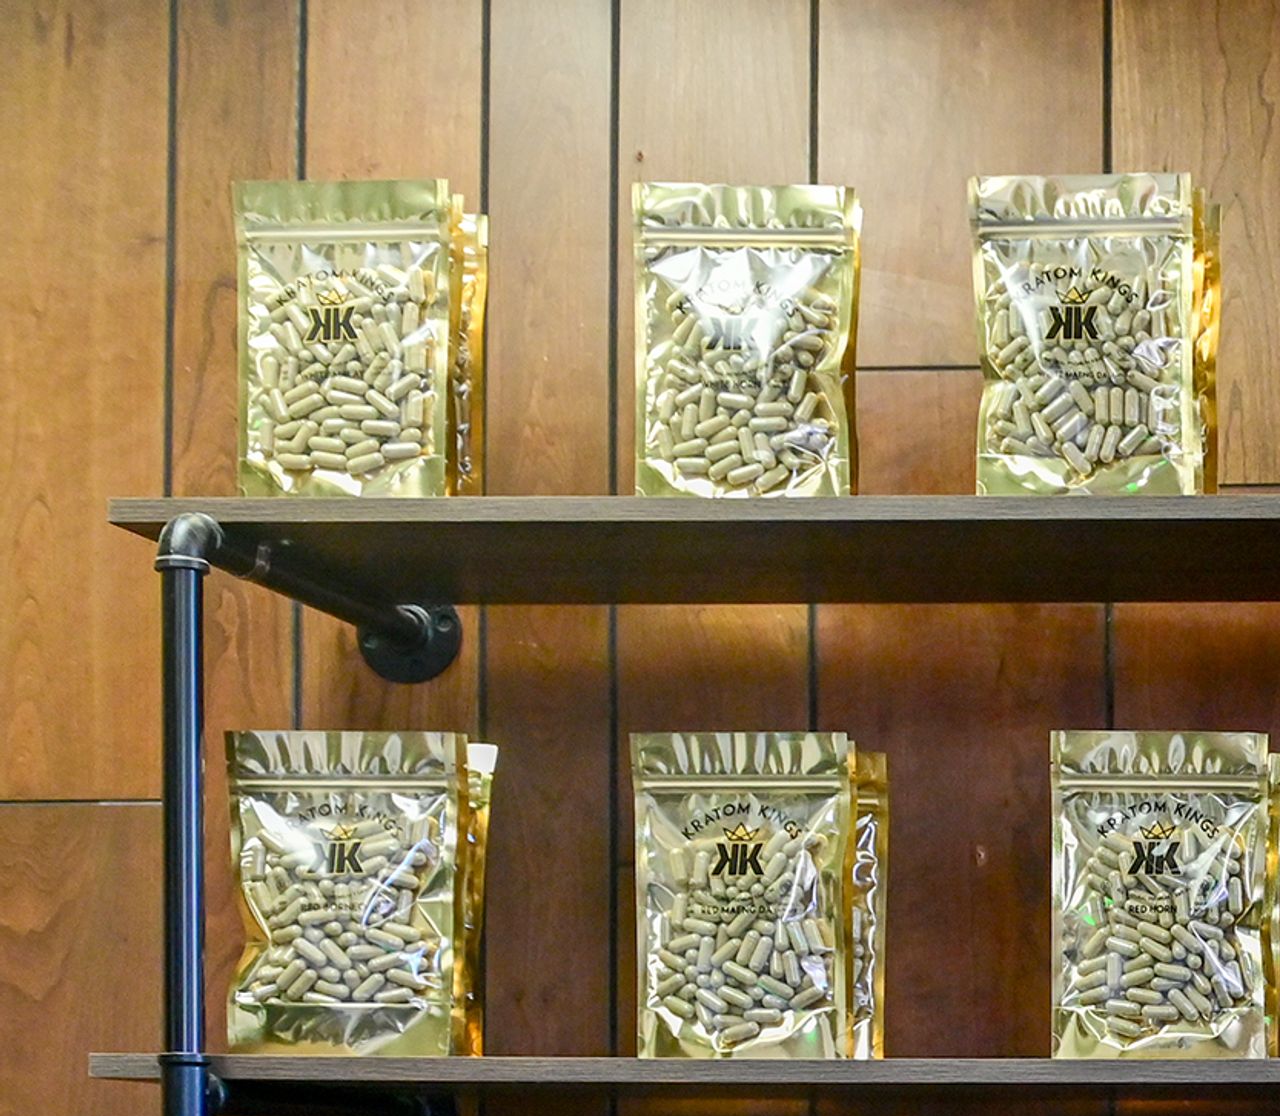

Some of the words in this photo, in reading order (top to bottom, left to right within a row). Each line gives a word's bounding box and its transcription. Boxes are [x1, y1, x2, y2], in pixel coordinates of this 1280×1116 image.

[276, 269, 348, 307] KRATOM
[352, 268, 395, 303] KINGS
[1020, 267, 1083, 296] RATOM
[1090, 268, 1140, 304] KINGS
[681, 802, 751, 841] KRATOM
[757, 803, 803, 840] KINGS
[1096, 801, 1168, 839] KRATOM
[1173, 802, 1221, 840] KINGS
[1128, 904, 1148, 915] RED
[1149, 904, 1178, 914] HORN
